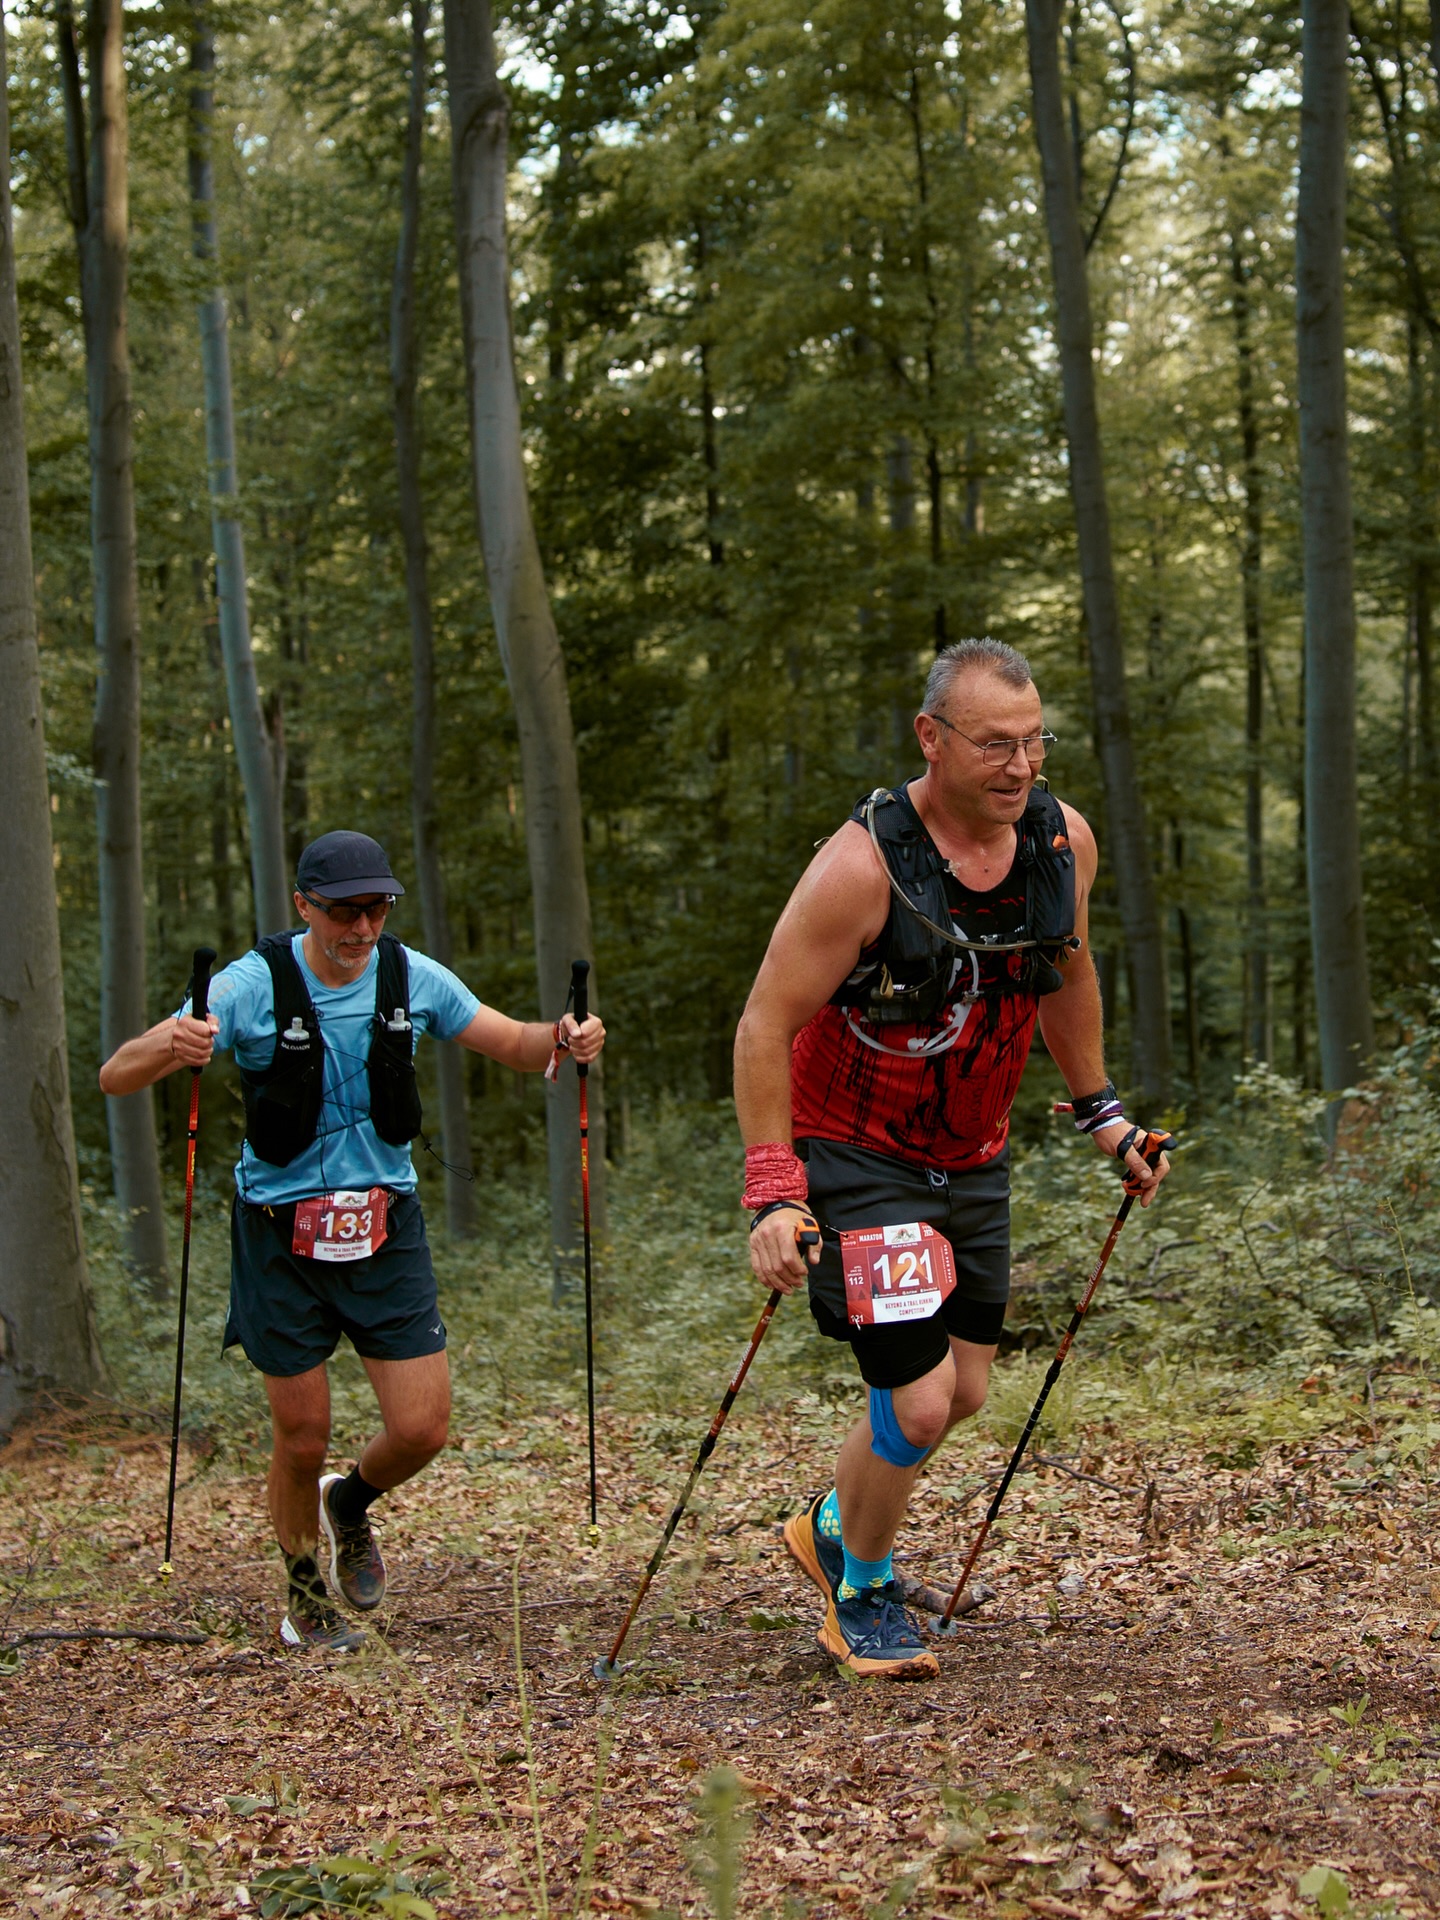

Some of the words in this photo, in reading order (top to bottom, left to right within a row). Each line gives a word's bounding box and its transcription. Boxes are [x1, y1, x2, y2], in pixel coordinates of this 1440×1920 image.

[281, 1041, 310, 1050] SALOMON
[299, 1223, 311, 1231] 112
[321, 1209, 373, 1239] 133
[859, 1233, 883, 1242] MARATON
[873, 1248, 934, 1290] 121
[849, 1277, 864, 1285] 112
[885, 1300, 903, 1309] BEYOND
[899, 1307, 925, 1316] COMPETITION
